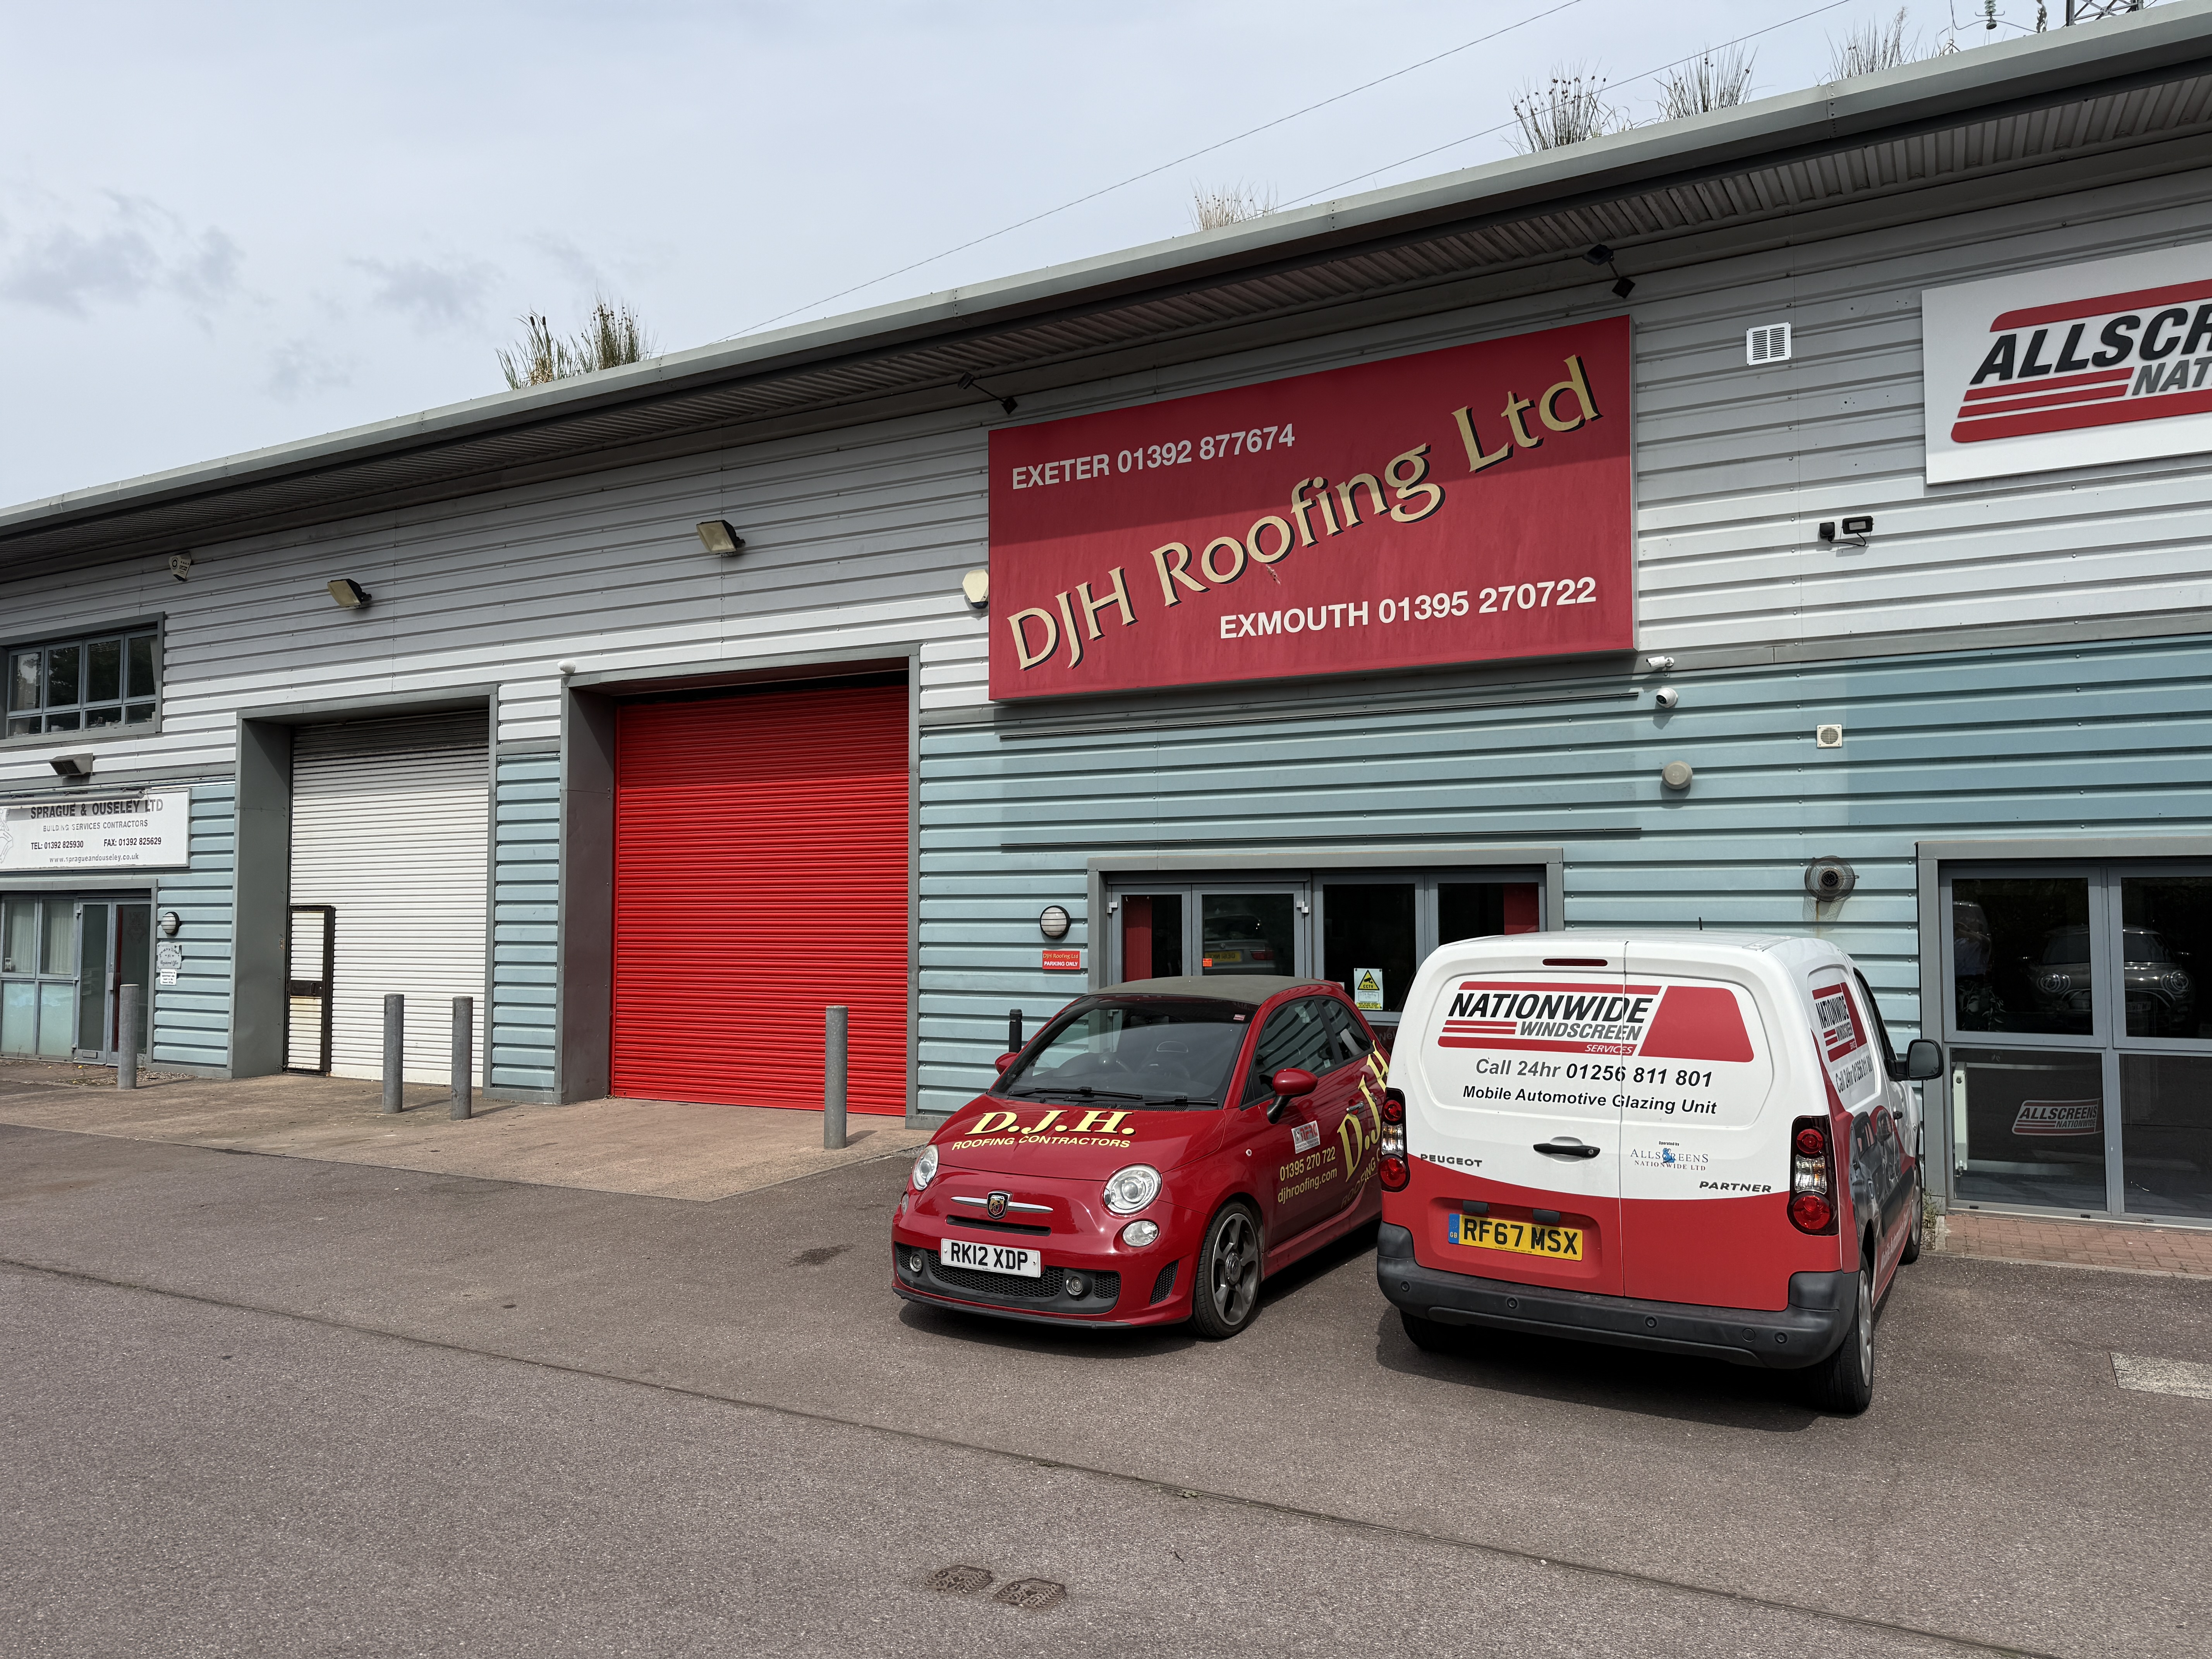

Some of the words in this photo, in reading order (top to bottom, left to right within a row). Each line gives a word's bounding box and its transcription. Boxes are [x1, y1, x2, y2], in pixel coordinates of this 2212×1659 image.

[2131, 356, 2212, 396] NAT
[1012, 453, 1109, 490] EXETER
[1118, 441, 1192, 474] 01392
[1200, 424, 1294, 459] 877674
[1007, 566, 1138, 670] DJH
[1150, 443, 1445, 607] Roofing
[1452, 354, 1604, 474] Ltd
[1220, 601, 1369, 640] EXMOUTH
[1379, 590, 1468, 625] 01395
[1479, 577, 1596, 614] 270722
[31, 803, 76, 819] SPRAGUE
[81, 804, 87, 816] &
[92, 800, 140, 816] OUSELEY
[145, 799, 163, 812] LTD
[43, 824, 69, 832] BUILDING
[72, 822, 100, 831] SERVICES
[103, 819, 148, 829] CONTRACTORS
[62, 841, 84, 849] 825930
[139, 837, 161, 845] 825629
[50, 853, 139, 864] www.spragueandouseley.co.uk
[1448, 993, 1654, 1023] NATIONWIDE
[1815, 995, 1850, 1029] NATIONWIDE
[1520, 1021, 1643, 1041] WINDSCREEN
[1585, 1044, 1633, 1054] SERVICES
[1476, 1058, 1511, 1075] Call
[1517, 1061, 1561, 1078] 24hr
[1566, 1063, 1626, 1082] 01256
[1633, 1067, 1667, 1084] 811
[1675, 1070, 1712, 1087] 801
[1836, 1068, 1844, 1094] Call
[1463, 1085, 1511, 1100] Mobile
[1515, 1088, 1606, 1106] Automotive
[1612, 1094, 1675, 1114] Glazing
[1681, 1099, 1717, 1114] Unit
[964, 1110, 1135, 1135] D.J.H.
[2019, 1106, 2097, 1120] ALLSCREENS
[2056, 1119, 2096, 1128] NATIONWIDE
[951, 1137, 1015, 1151] ROOFING
[1018, 1135, 1131, 1148] CONTRACTORS
[1280, 1159, 1304, 1182] 01395
[1307, 1152, 1320, 1171] 270
[1322, 1146, 1336, 1165] 722
[1420, 1154, 1482, 1167] PEUGEOT
[1634, 1160, 1687, 1170] NATIONWIDE
[1278, 1167, 1337, 1204] djhroofing.com
[1341, 1157, 1376, 1209] ROOFING
[1699, 1181, 1771, 1193] PARTNER
[1464, 1218, 1523, 1247] RF67
[1531, 1227, 1578, 1255] MSX
[951, 1242, 988, 1266] RK12
[994, 1248, 1028, 1270] XDP
